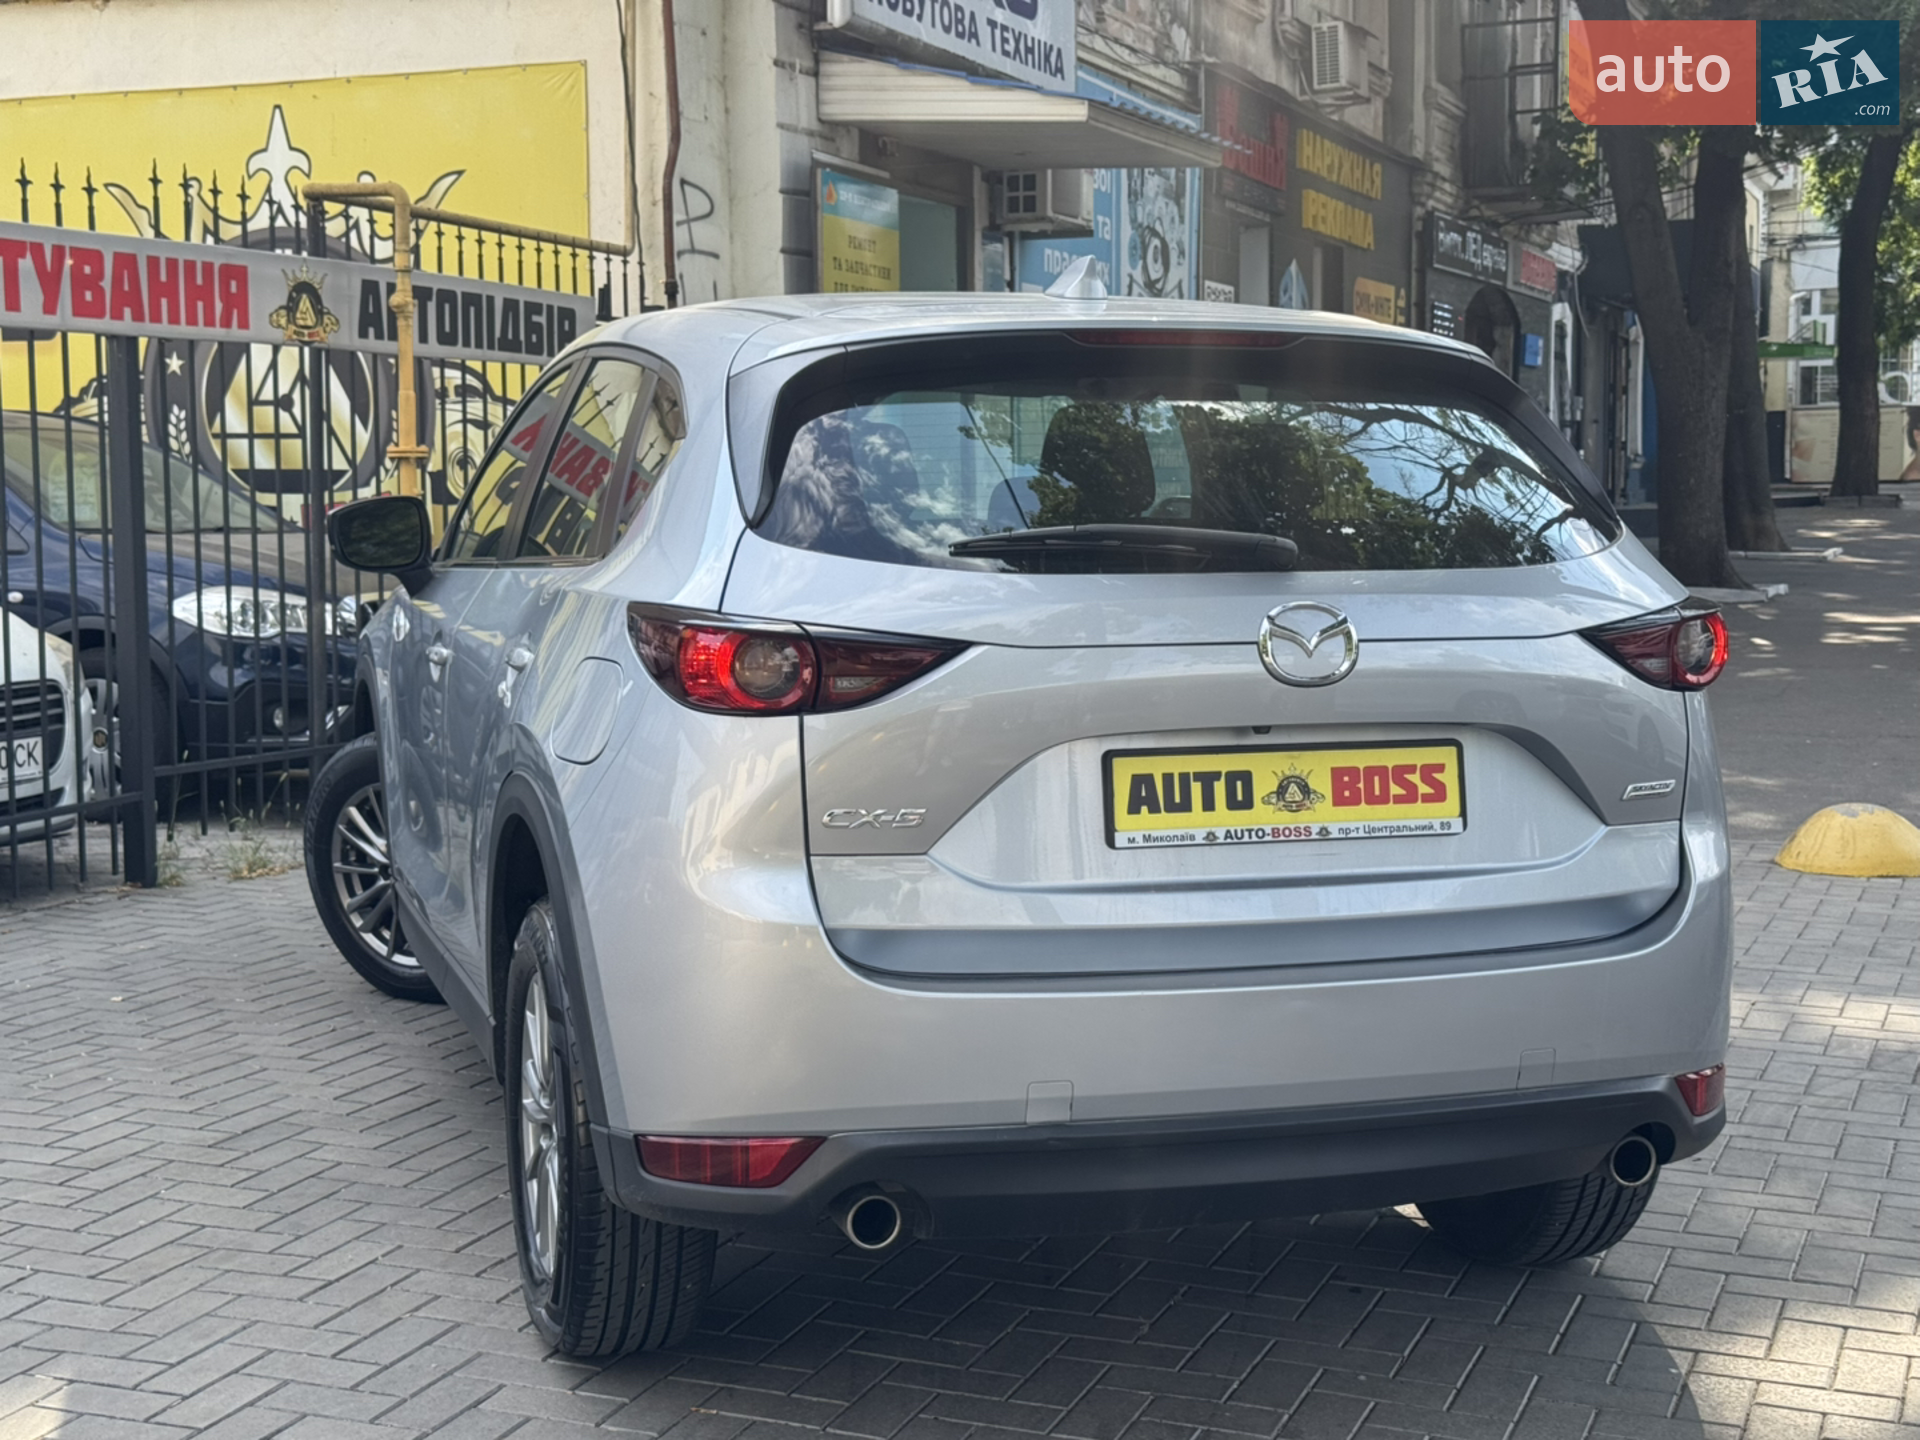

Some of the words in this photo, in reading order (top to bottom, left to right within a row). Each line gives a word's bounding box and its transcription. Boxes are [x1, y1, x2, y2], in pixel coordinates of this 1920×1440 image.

[986, 17, 1066, 81] ТЕХНІКА
[1296, 128, 1382, 200] НАРУЖНАЯ
[1097, 215, 1111, 241] та
[1302, 189, 1374, 250] РЕКЛАМА
[0, 238, 250, 330] ТУВАННЯ
[1127, 770, 1254, 815] AUTO
[1331, 763, 1447, 807] BOSS
[822, 808, 927, 828] CX-5
[1224, 827, 1313, 842] AUTO-BOSS
[1338, 825, 1360, 837] пр-т
[1362, 821, 1438, 836] Центральний,
[1440, 821, 1452, 831] 89
[1142, 832, 1196, 844] Миколаїв
